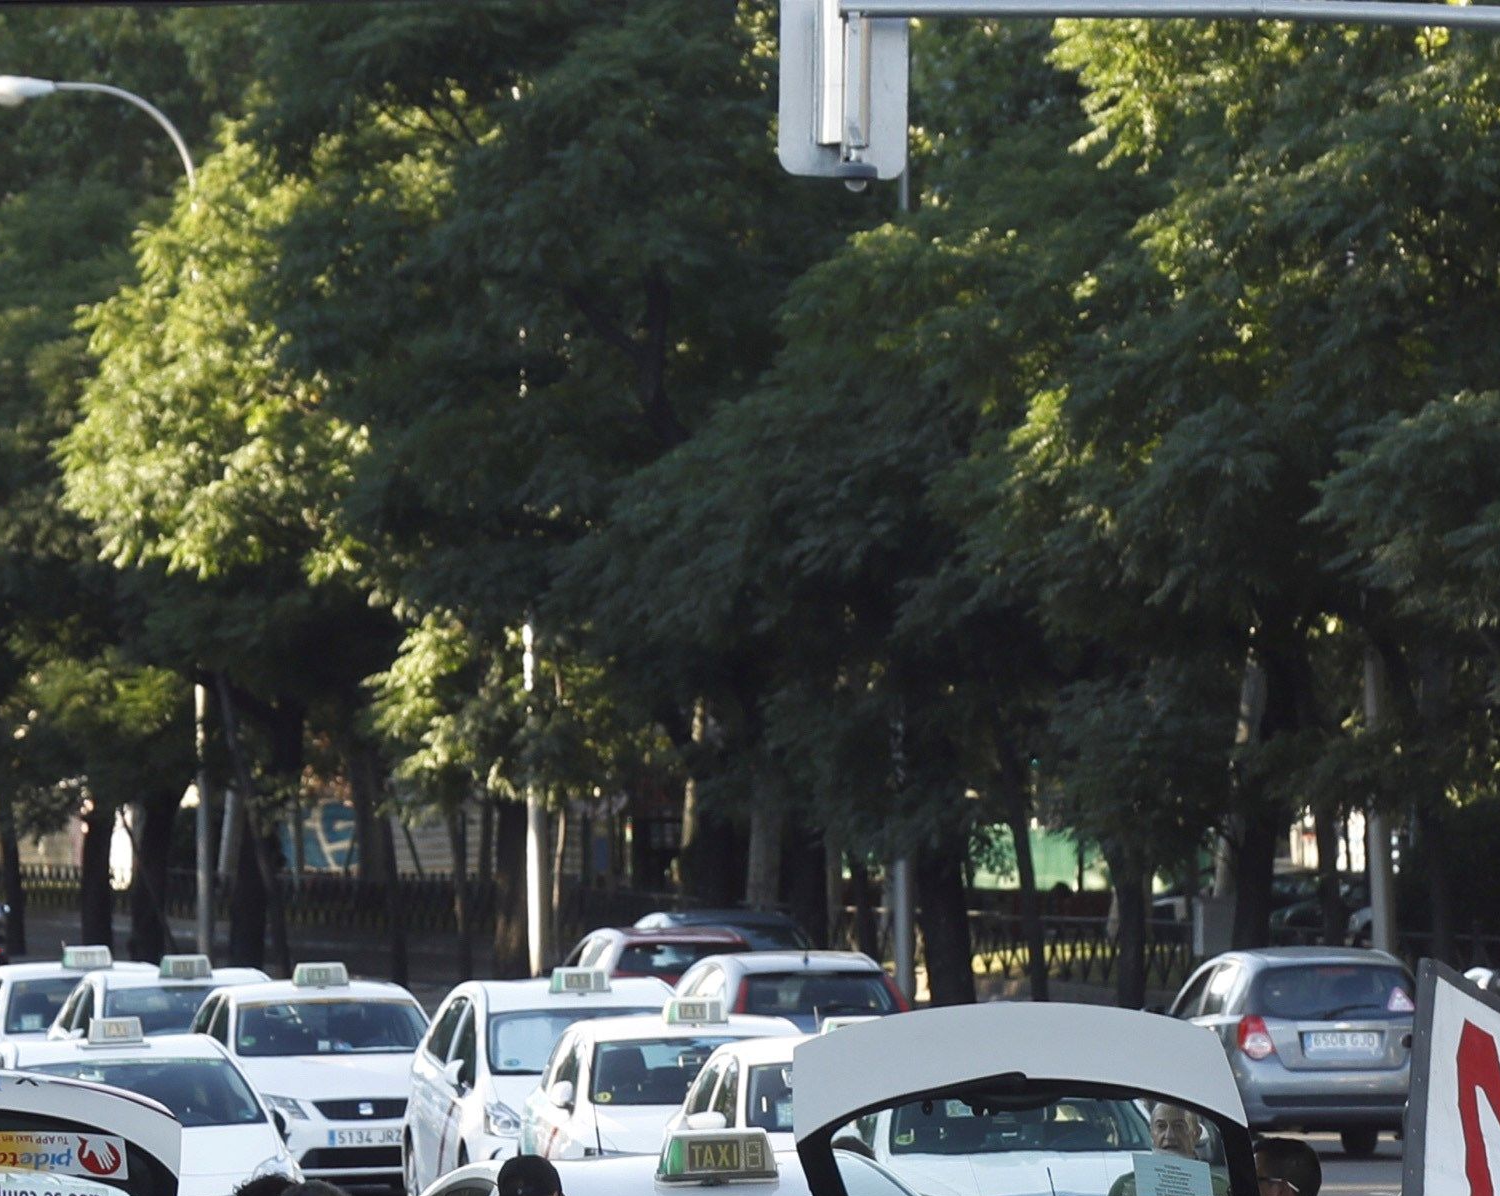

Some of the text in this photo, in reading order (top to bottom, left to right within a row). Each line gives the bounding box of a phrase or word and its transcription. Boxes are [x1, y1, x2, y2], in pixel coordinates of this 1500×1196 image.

[680, 1003, 706, 1019] TAXI
[34, 1135, 55, 1145] APP
[338, 1131, 373, 1144] 5134
[693, 1142, 739, 1170] TAXI
